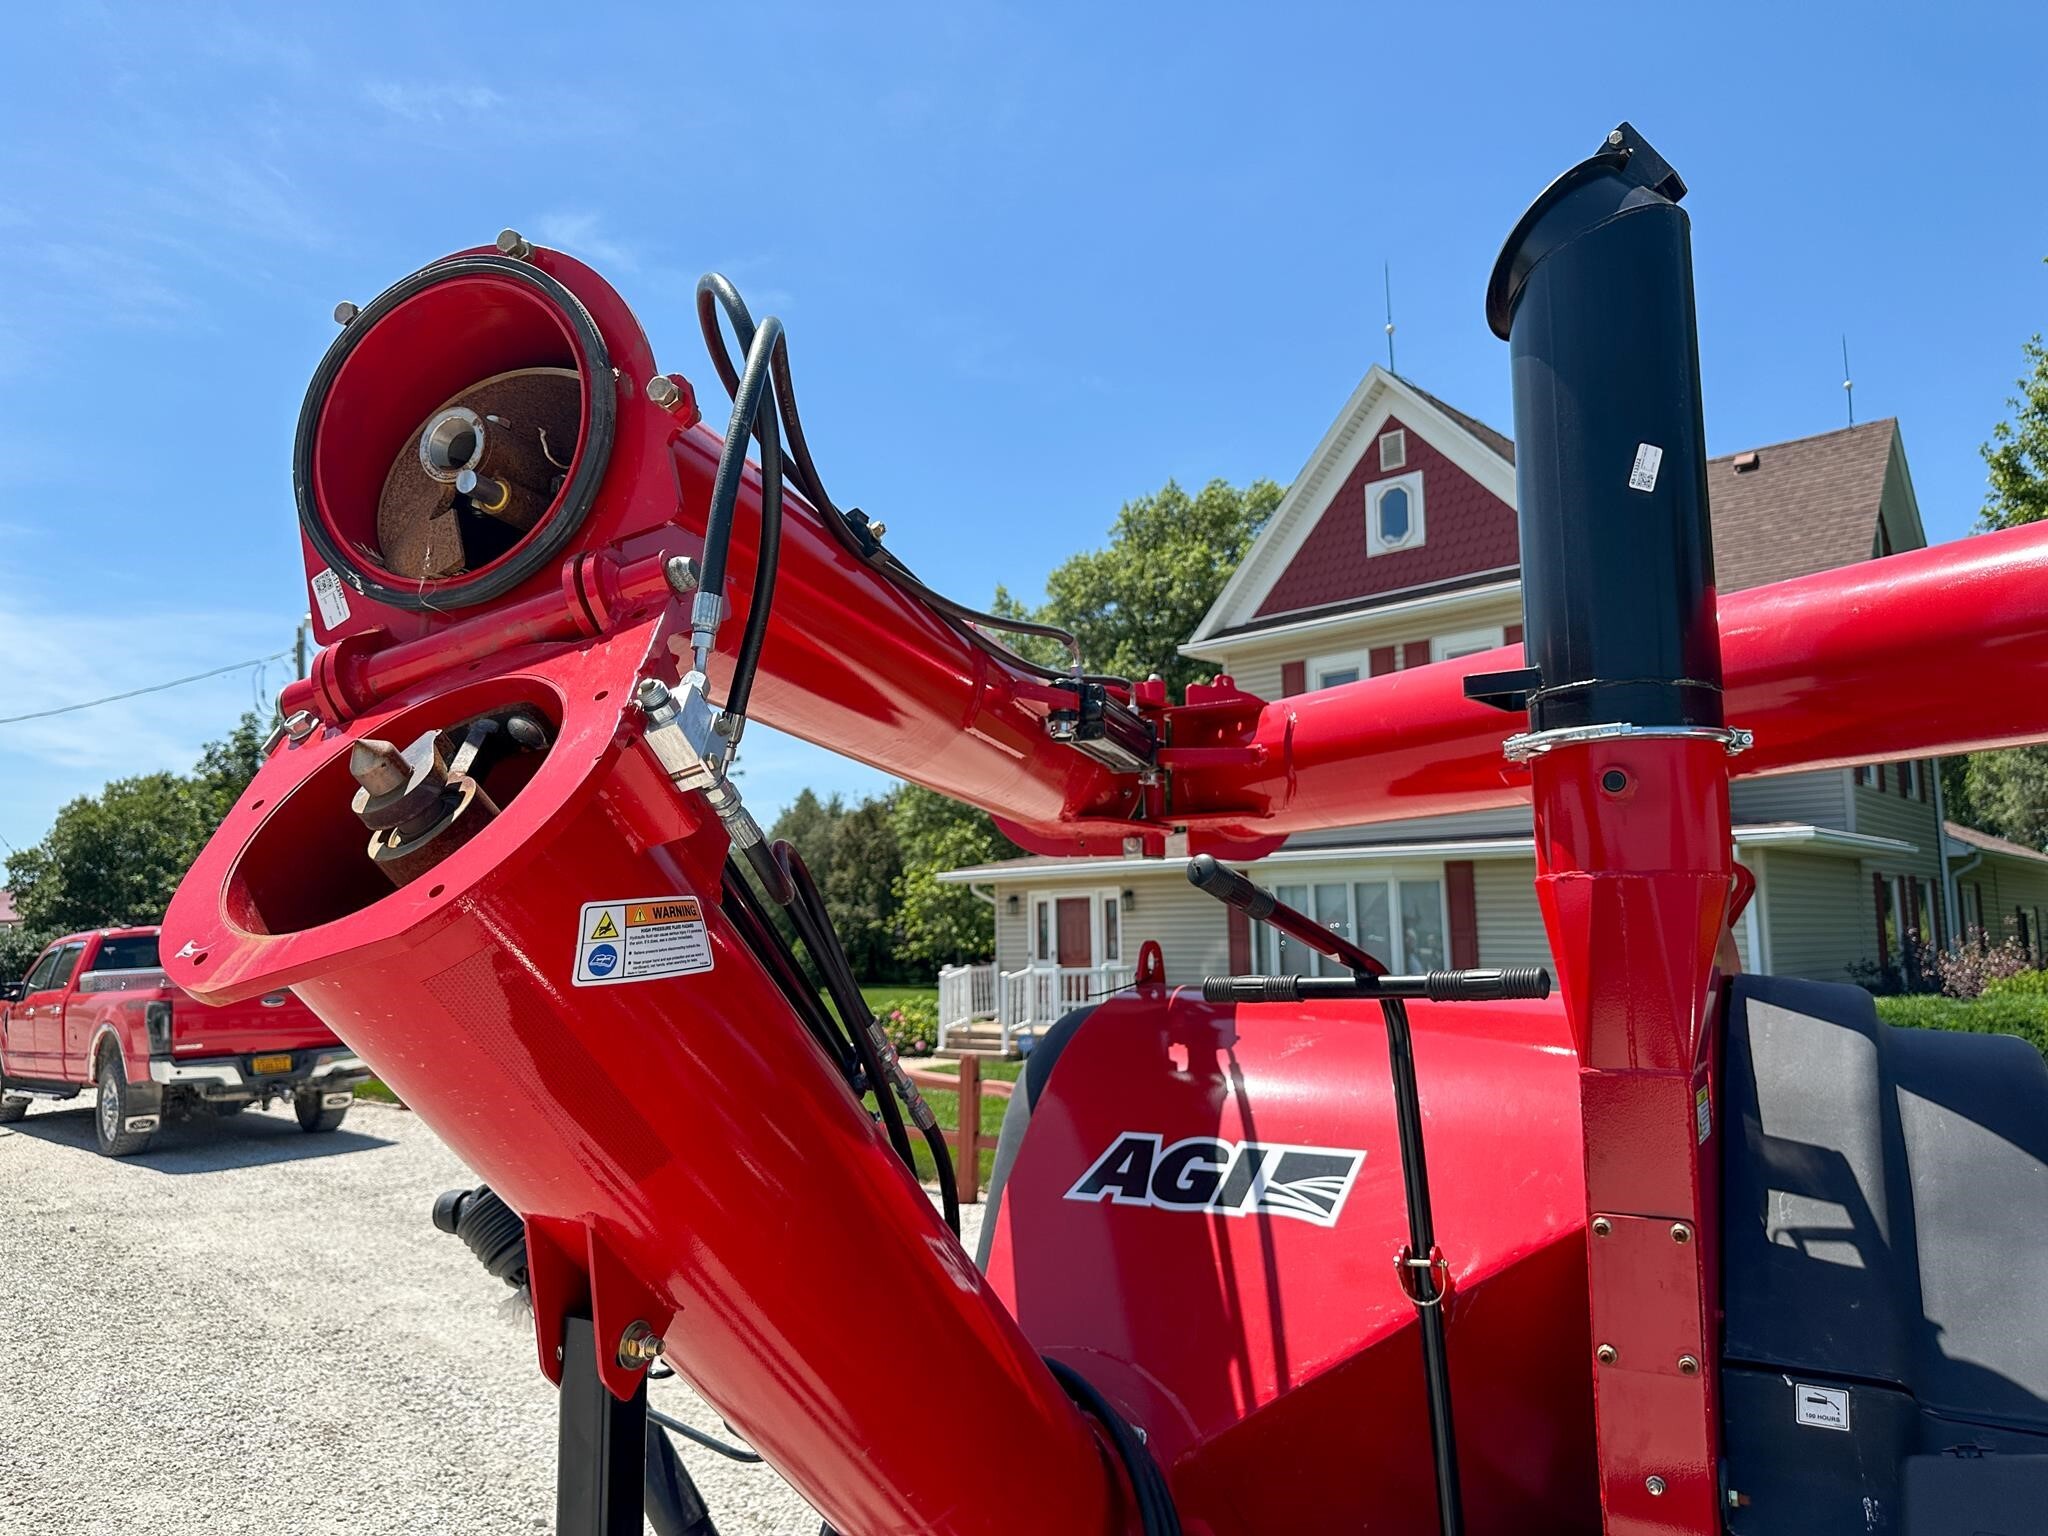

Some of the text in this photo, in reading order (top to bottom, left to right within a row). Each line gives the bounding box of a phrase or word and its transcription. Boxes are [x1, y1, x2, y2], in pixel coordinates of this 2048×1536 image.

[652, 905, 697, 920] WARNING
[1070, 1134, 1269, 1212] AGI
[1817, 1414, 1840, 1422] HOURS
